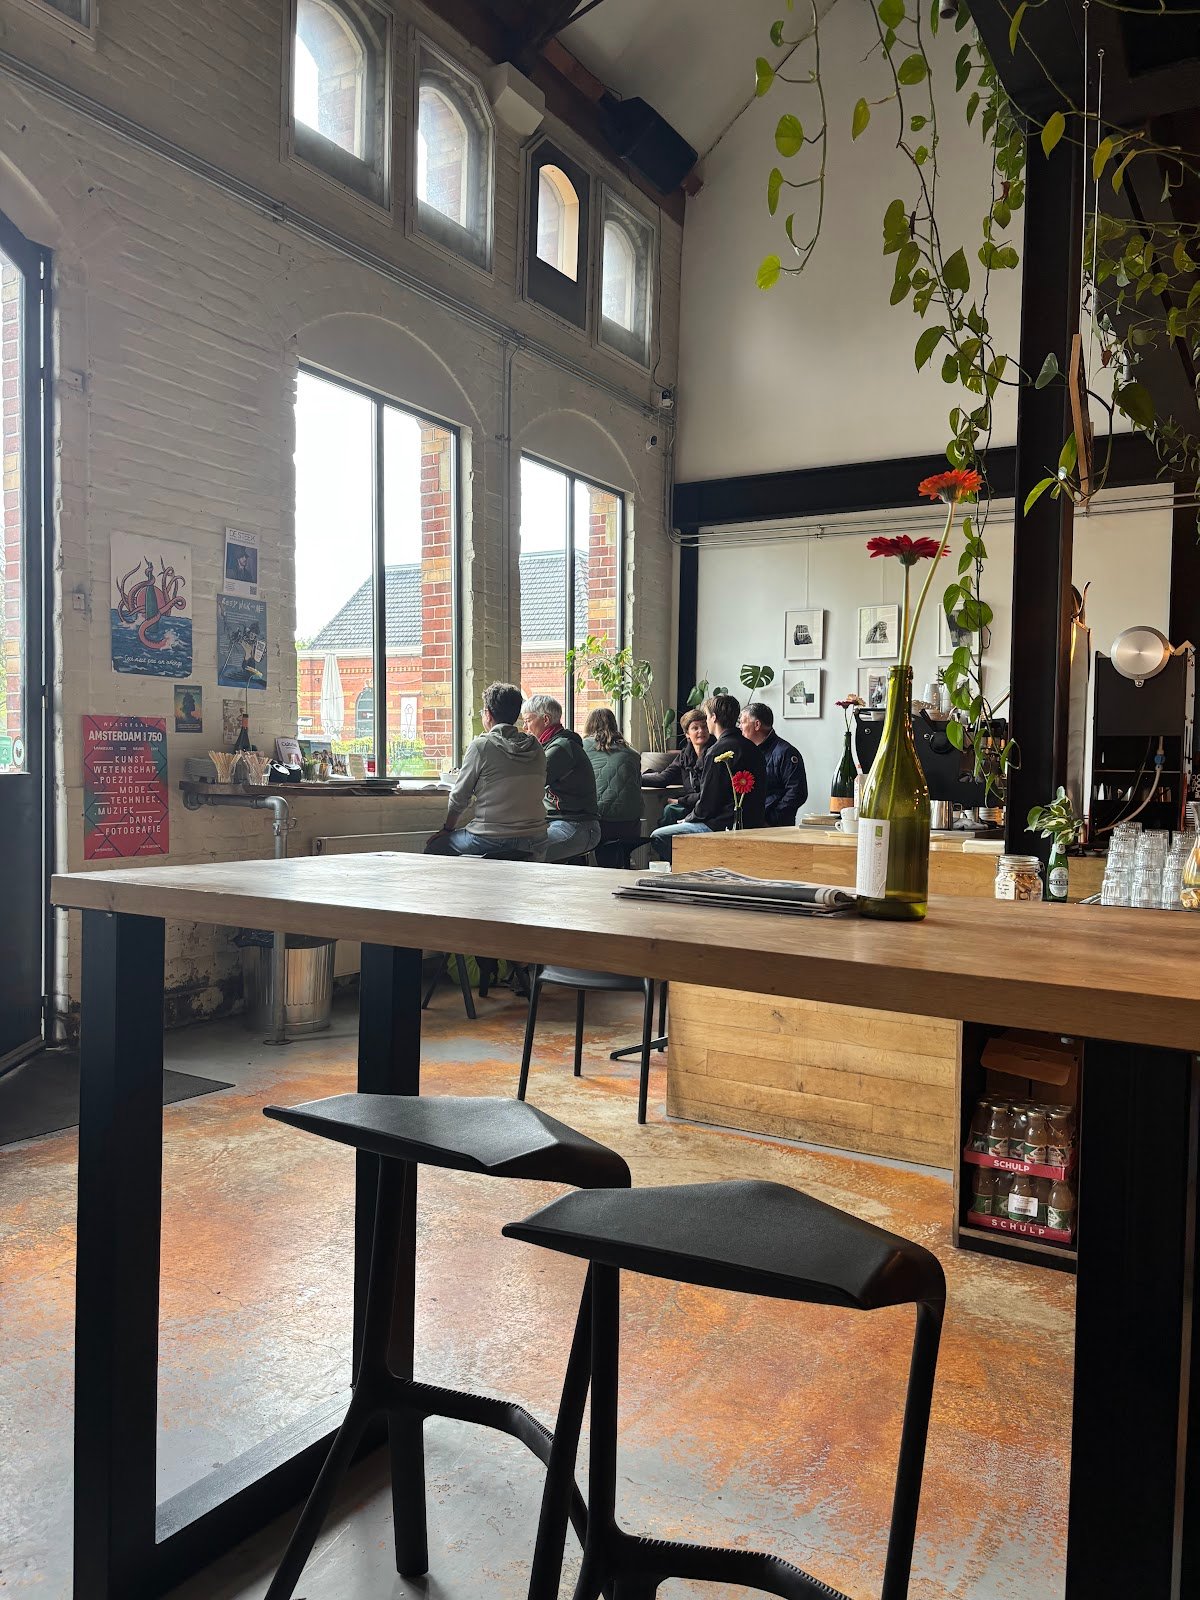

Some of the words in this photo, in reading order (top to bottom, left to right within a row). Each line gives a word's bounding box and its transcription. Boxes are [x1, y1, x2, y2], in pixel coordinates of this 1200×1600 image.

[89, 730, 142, 741] AMSTERDAM
[147, 732, 163, 742] 750
[115, 755, 145, 763] KUNST
[100, 776, 134, 784] POEZIE
[119, 786, 146, 794] MODE
[129, 815, 153, 824] DANS
[105, 824, 161, 835] FOTOGRAFIE
[993, 1159, 1030, 1172] SCHULP
[991, 1218, 1045, 1236] SCHULP
